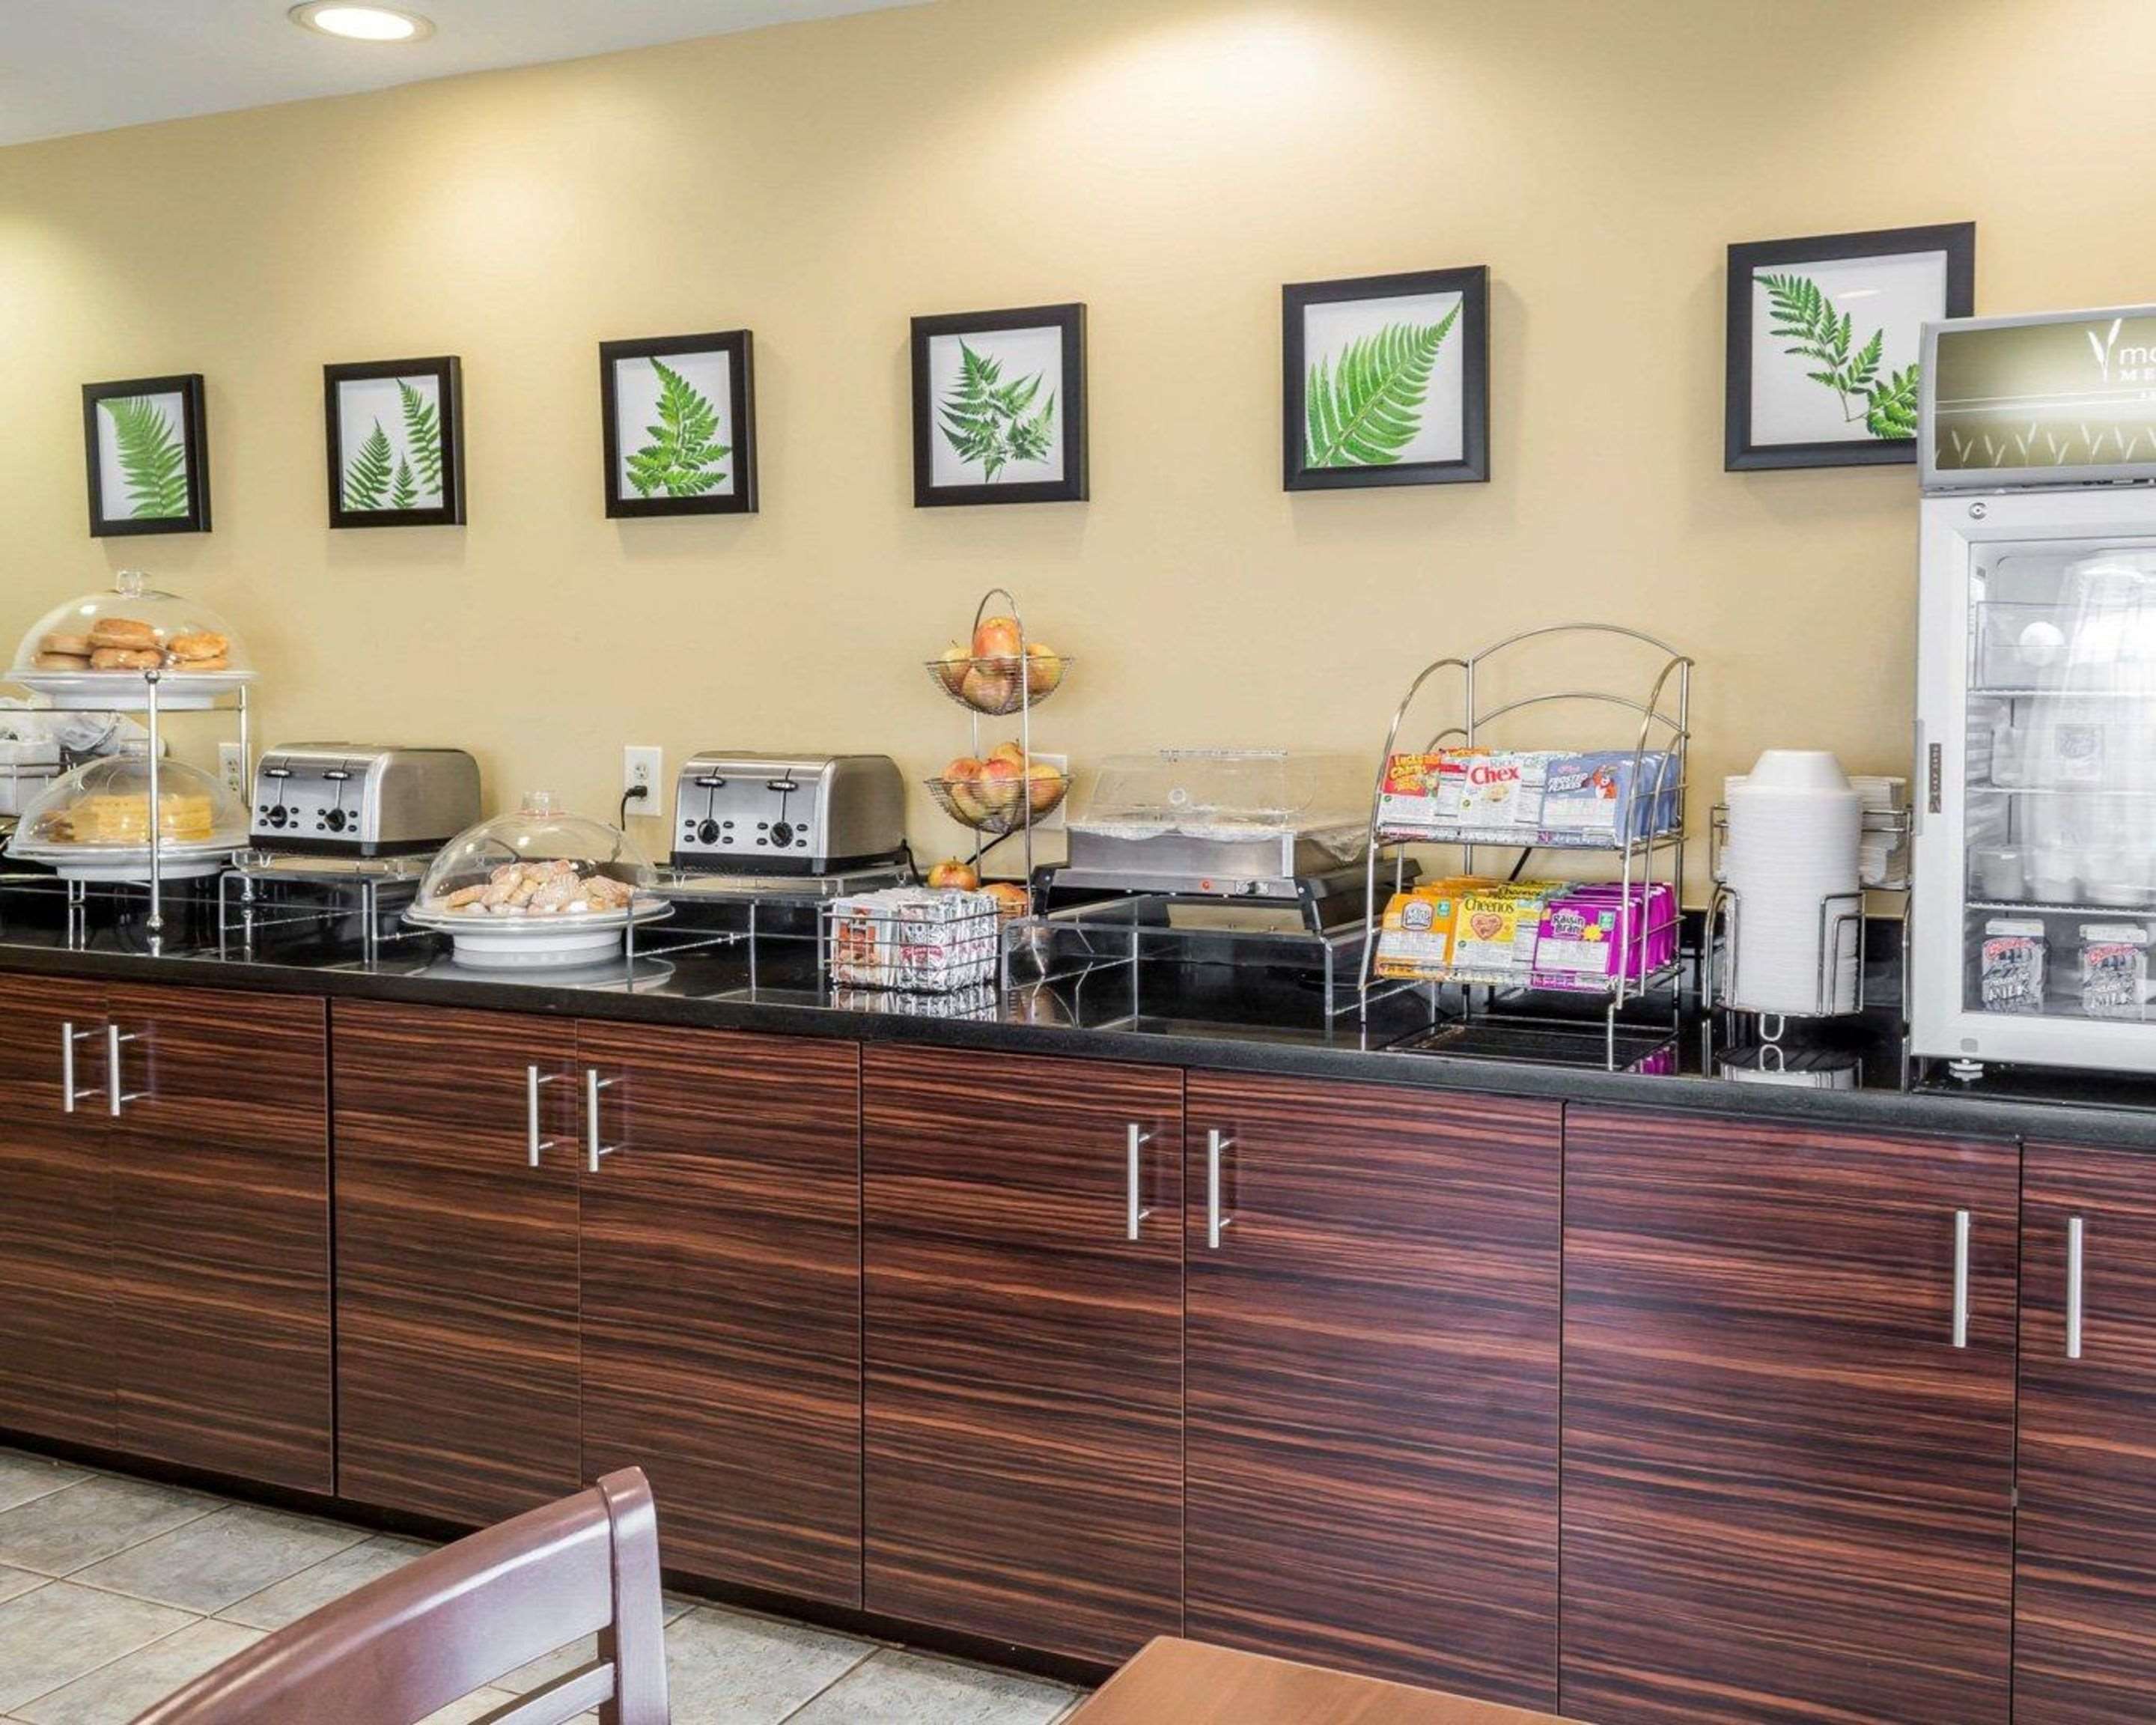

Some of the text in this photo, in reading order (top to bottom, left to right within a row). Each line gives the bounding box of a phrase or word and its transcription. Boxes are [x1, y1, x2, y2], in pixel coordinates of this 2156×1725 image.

[1470, 766, 1520, 785] Chex
[1464, 898, 1514, 913] Cheerios
[1553, 913, 1584, 925] Raisin
[1555, 923, 1580, 934] Bran
